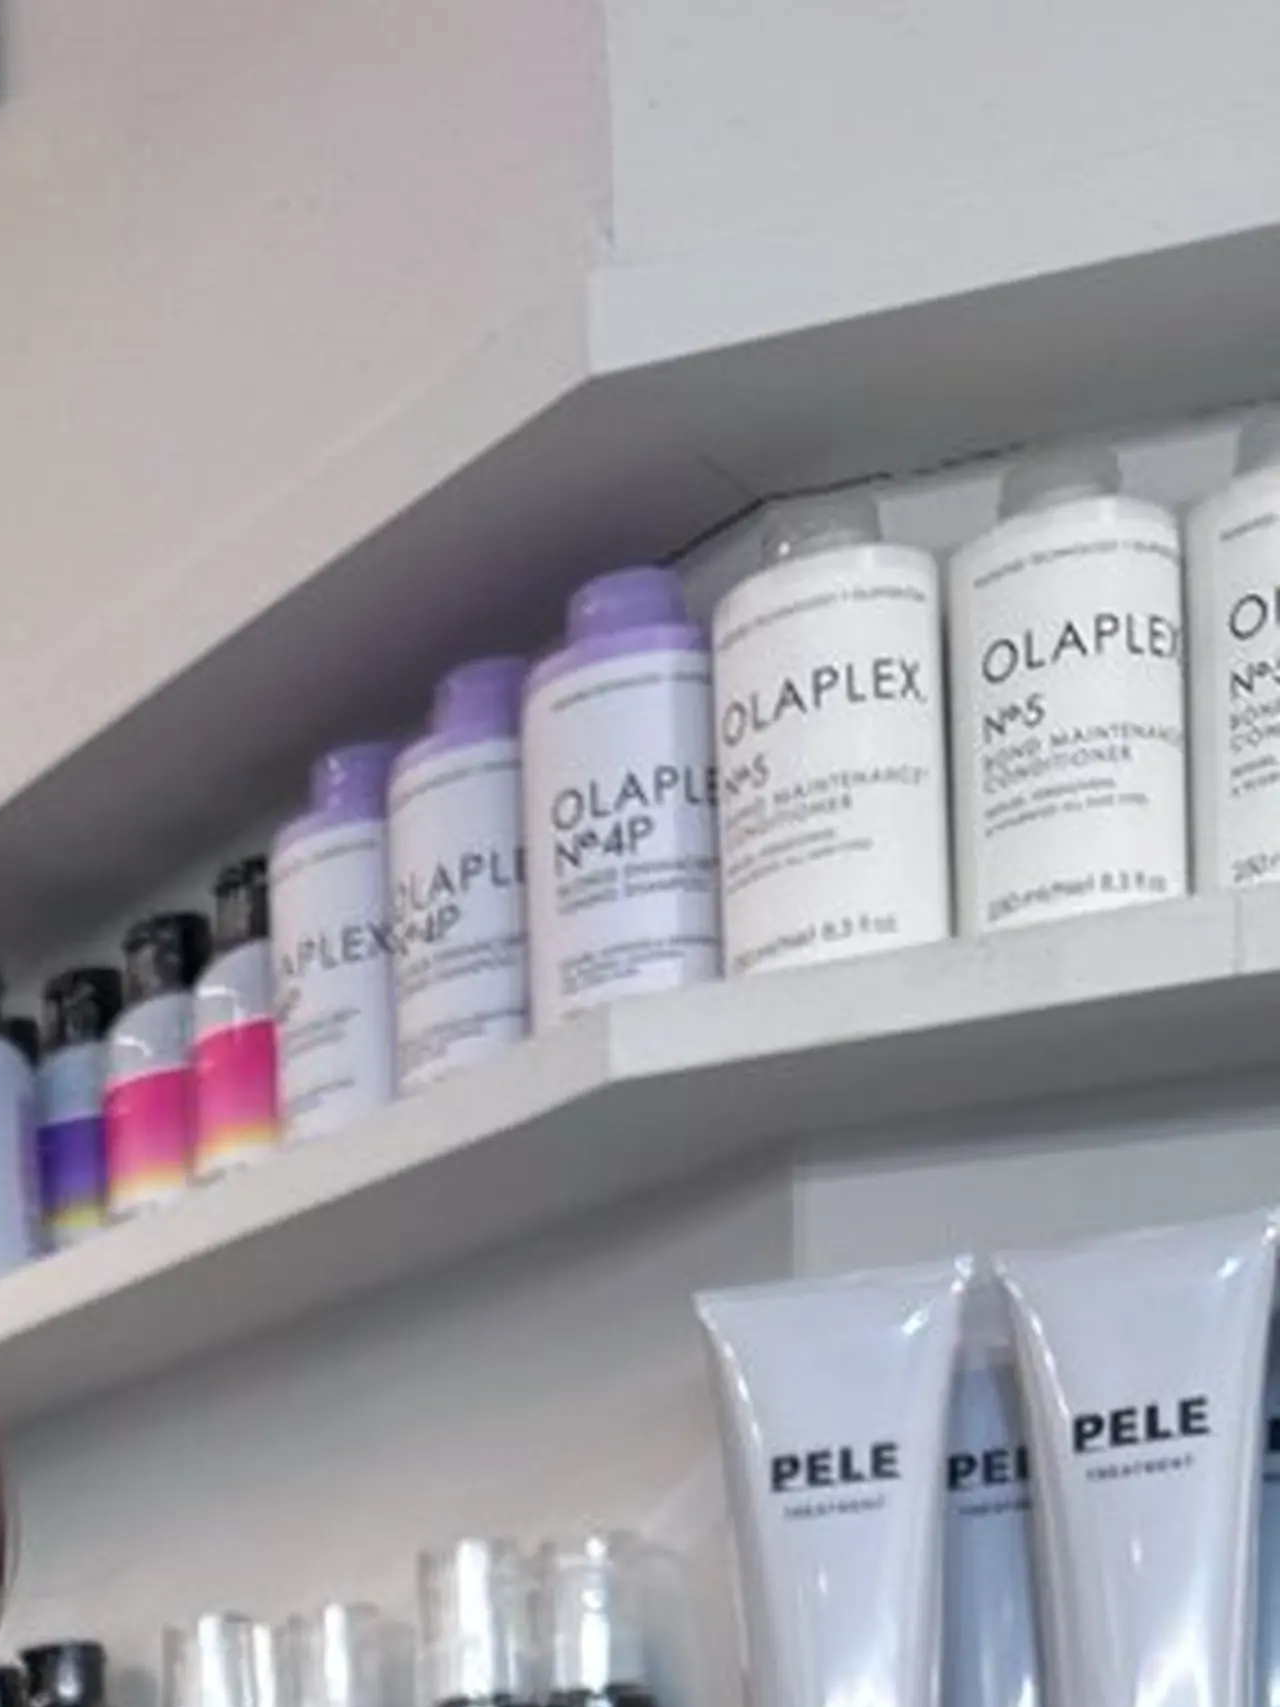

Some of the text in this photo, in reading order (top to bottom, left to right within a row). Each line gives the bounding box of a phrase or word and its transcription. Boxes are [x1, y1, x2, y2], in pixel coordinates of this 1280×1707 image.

[721, 656, 922, 749] OLAPLEX
[1072, 1394, 1211, 1454] PELE
[771, 1441, 902, 1493] PELE
